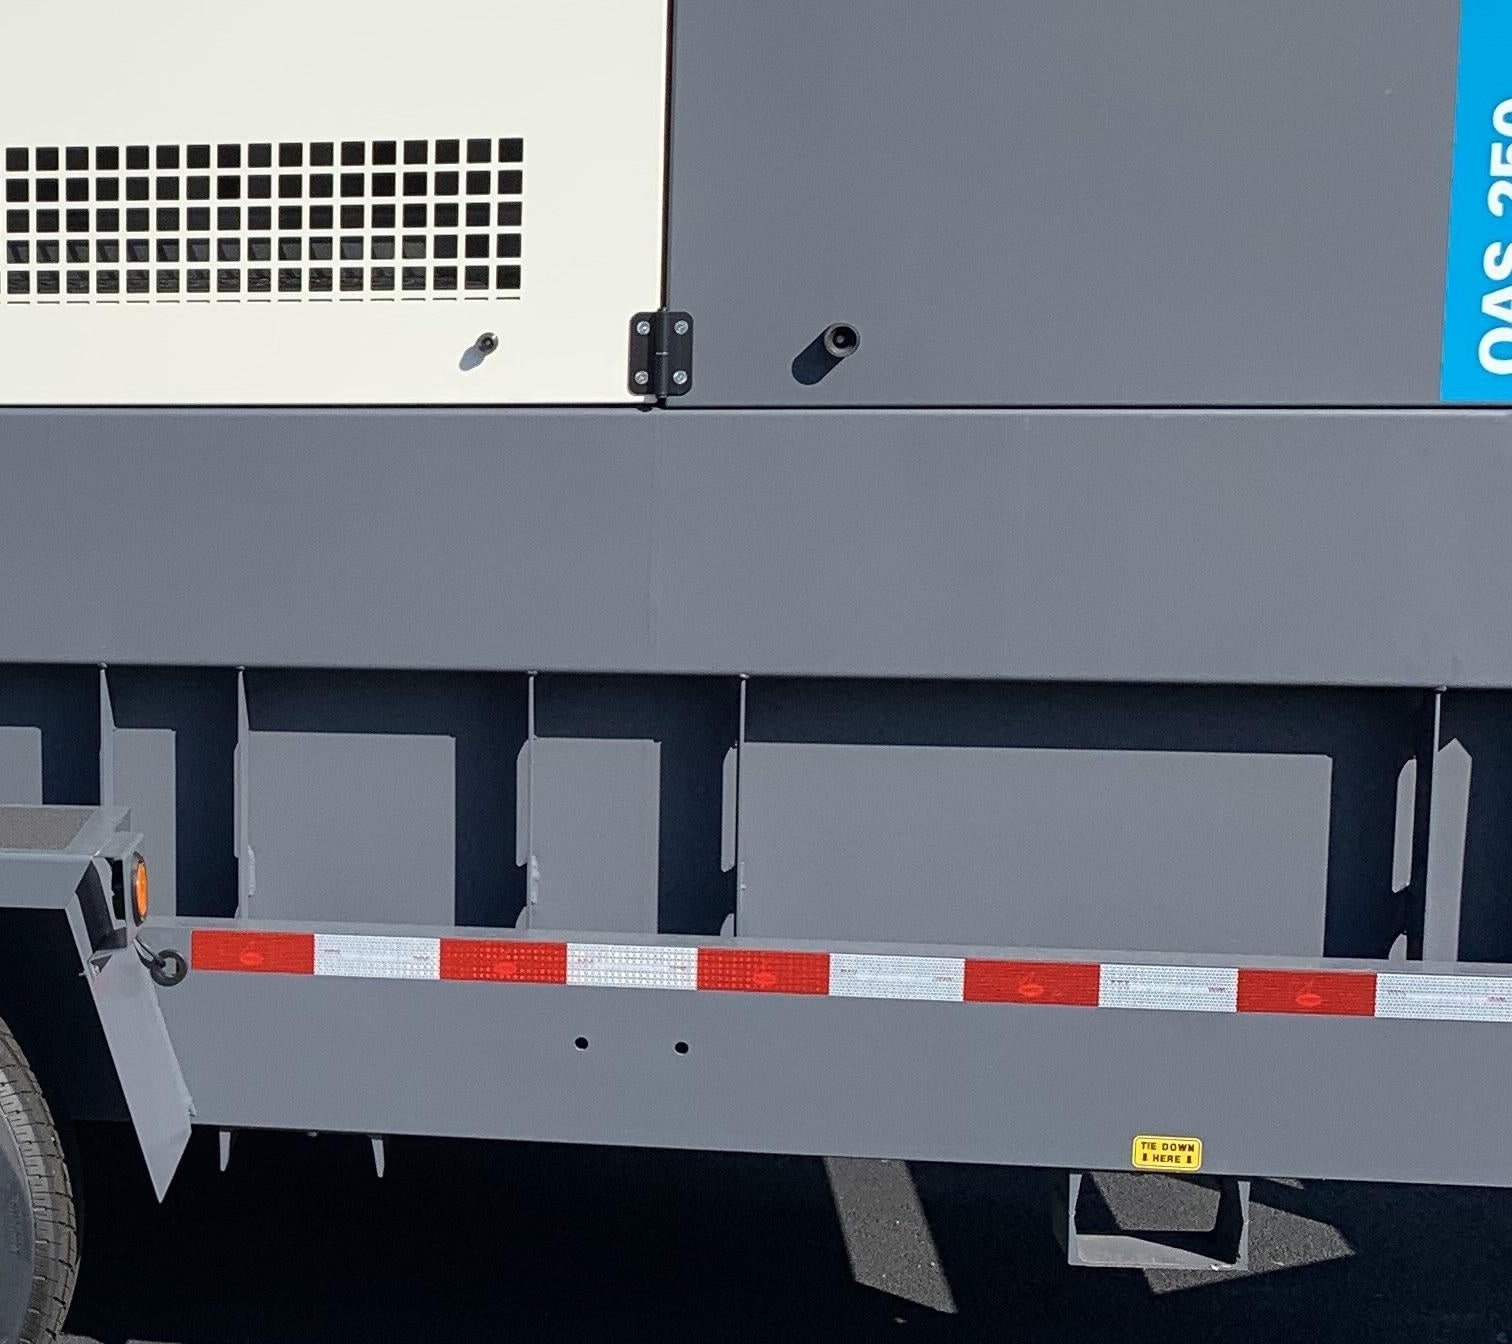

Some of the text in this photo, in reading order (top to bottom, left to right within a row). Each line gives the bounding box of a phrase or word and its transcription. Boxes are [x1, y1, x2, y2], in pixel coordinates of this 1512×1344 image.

[1140, 1141, 1195, 1152] TIE DOWN
[1152, 1154, 1181, 1163] HERE
